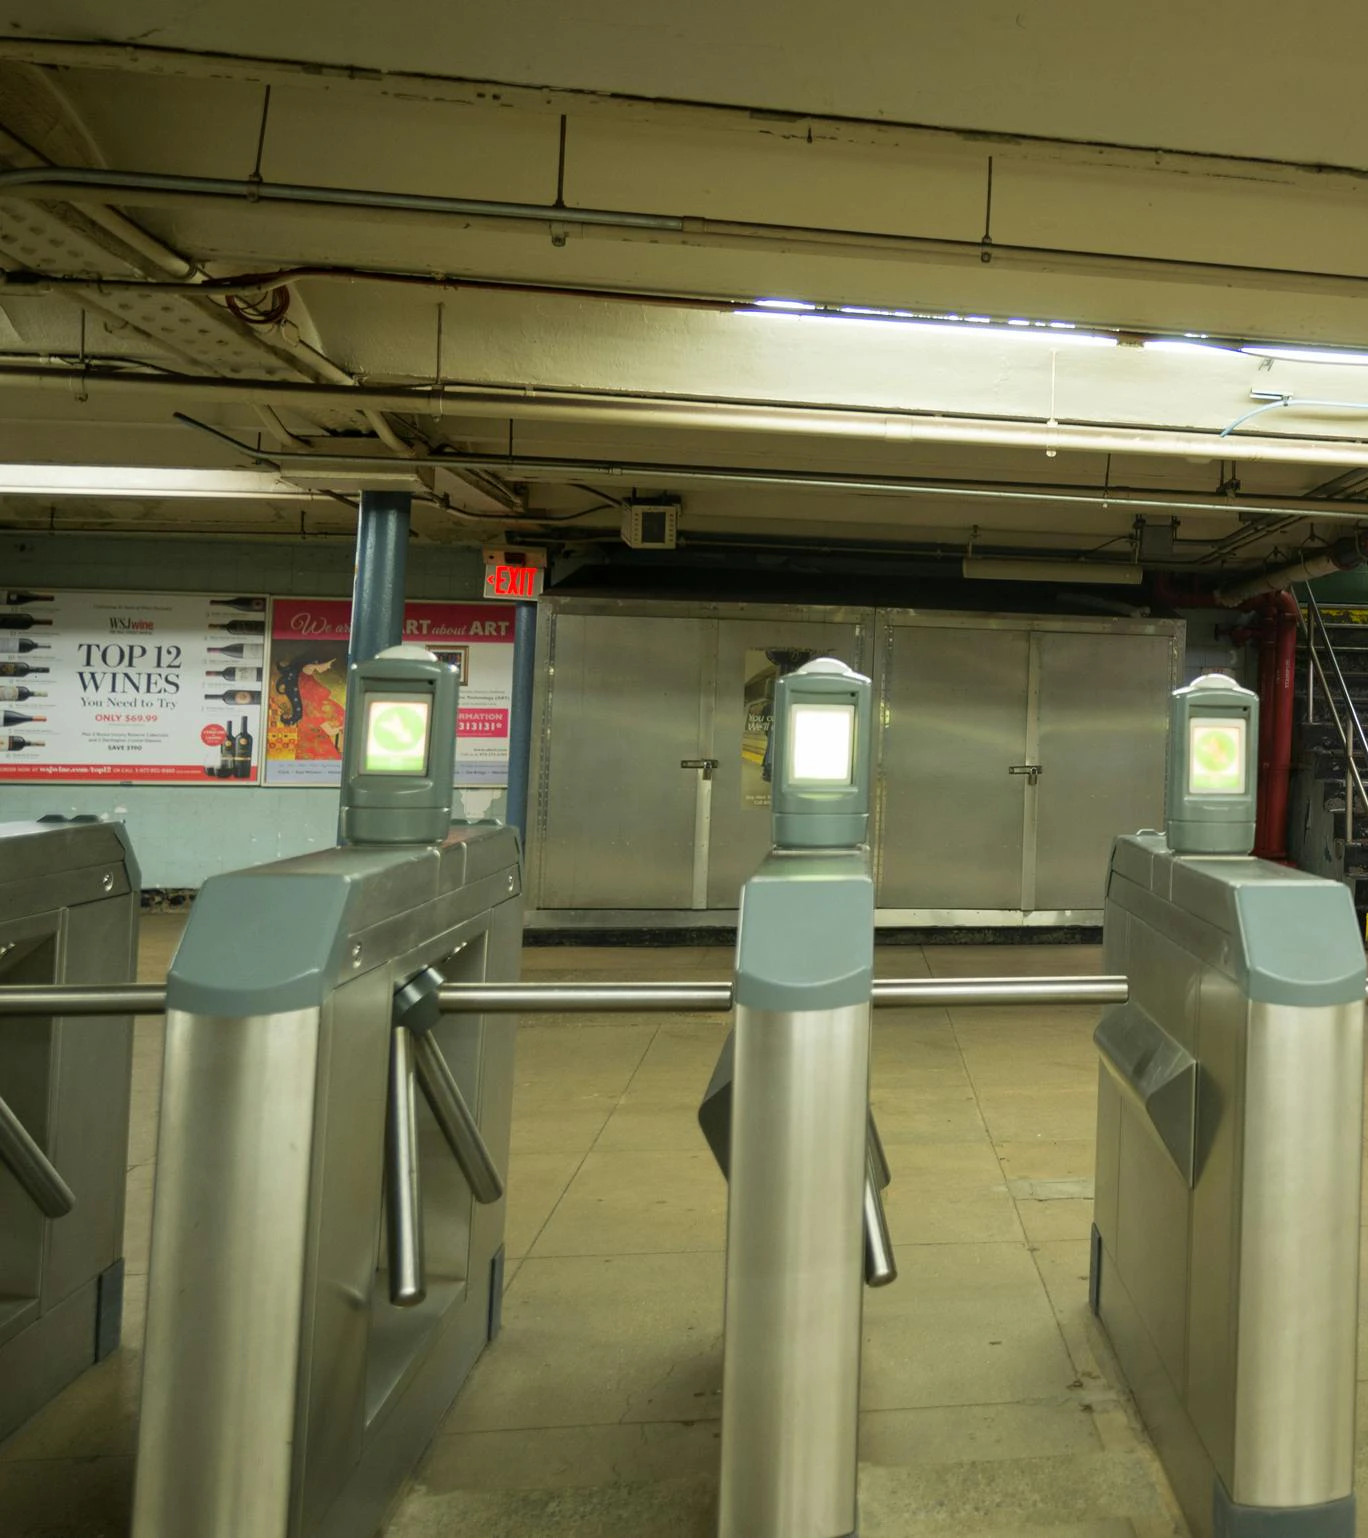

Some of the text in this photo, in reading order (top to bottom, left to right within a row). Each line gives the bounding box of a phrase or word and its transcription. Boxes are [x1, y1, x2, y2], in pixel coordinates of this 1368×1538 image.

[495, 565, 538, 597] EXIT
[109, 616, 154, 631] WSJwine
[290, 612, 510, 636] We ar RT about ART
[77, 643, 183, 669] TOP 12
[75, 671, 180, 694] WINES
[80, 696, 178, 711] You Need to Try
[95, 713, 158, 722] ONLY $69.99
[458, 712, 504, 720] RMATION
